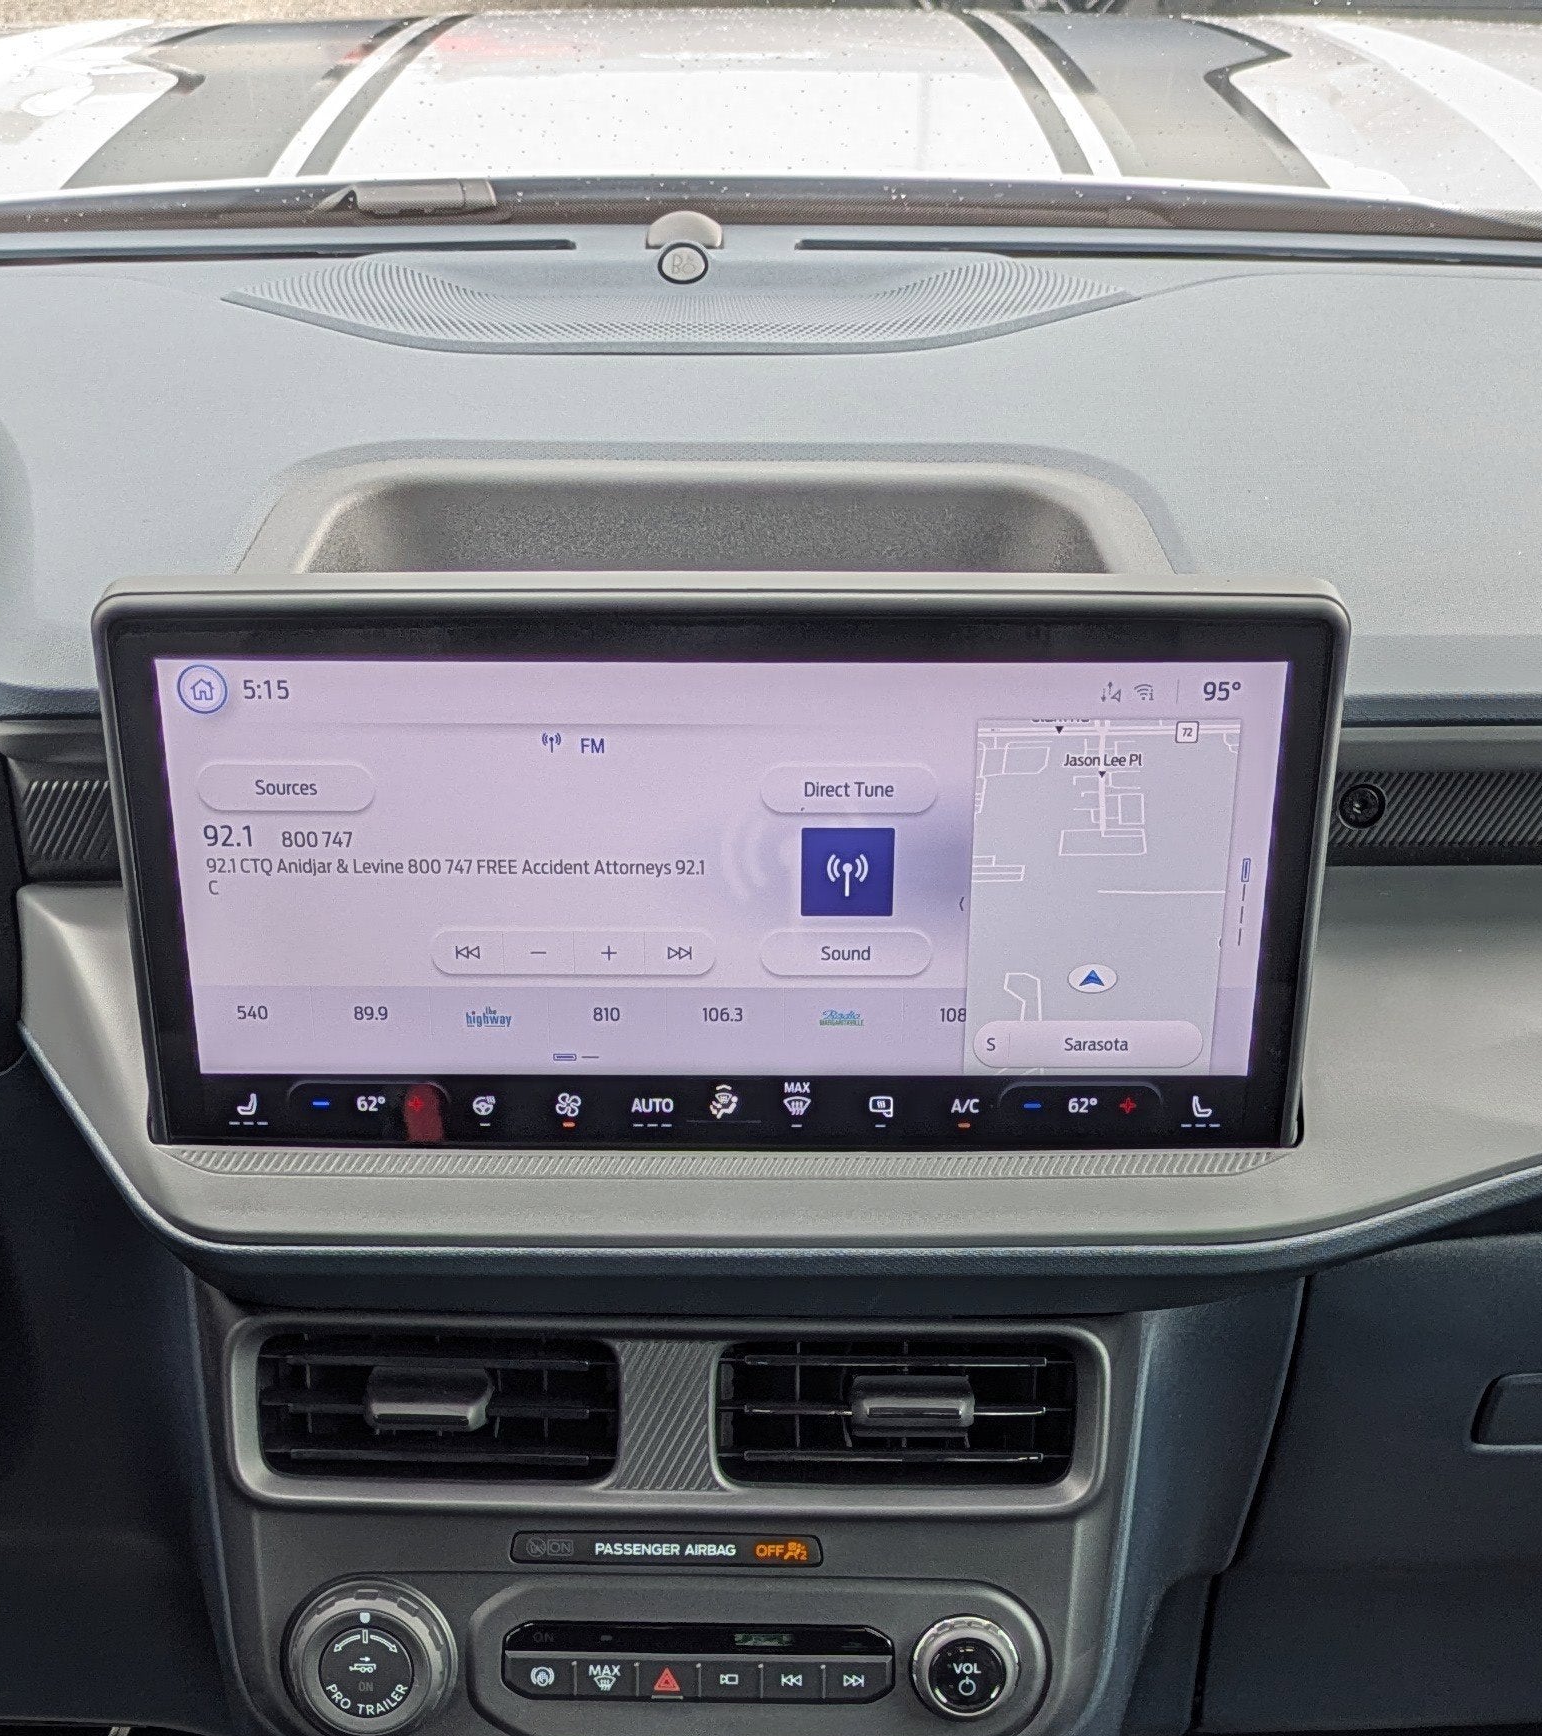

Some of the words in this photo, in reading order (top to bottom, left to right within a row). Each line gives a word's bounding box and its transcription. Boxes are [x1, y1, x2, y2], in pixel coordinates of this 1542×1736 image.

[242, 679, 290, 701] 5:15
[1202, 681, 1242, 702] 95°
[1182, 727, 1193, 738] 72
[580, 739, 605, 754] FM
[1063, 753, 1101, 767] Jason
[1103, 754, 1127, 766] Lee
[1129, 754, 1142, 766] Pl
[255, 779, 318, 796] Sources
[803, 781, 850, 799] Direct
[854, 782, 895, 799] Tune
[203, 825, 253, 847] 92.1
[281, 831, 318, 848] 800
[321, 831, 353, 848] 747
[205, 858, 236, 874] 92.1
[240, 858, 273, 877] CTQ
[276, 858, 332, 877] Anidjar
[336, 859, 349, 874] &
[353, 859, 404, 874] Levine
[407, 859, 442, 875] 800
[445, 859, 473, 875] 747
[477, 860, 518, 875] FREE
[521, 859, 590, 875] Accident
[594, 859, 672, 878] Attorneys
[675, 860, 705, 876] 92.1
[208, 880, 219, 896] C
[820, 945, 871, 962] Sound
[236, 1006, 269, 1021] 540
[353, 1006, 388, 1022] 89.9
[466, 1012, 512, 1027] highway
[592, 1007, 621, 1022] 810
[702, 1007, 744, 1024] 106.3
[986, 1037, 997, 1052] S
[1063, 1036, 1129, 1053] Sarasota
[784, 1082, 811, 1094] MAX
[356, 1096, 386, 1112] 62°
[631, 1098, 673, 1114] AUTO
[951, 1097, 980, 1116] A/C
[1068, 1097, 1098, 1114] 62°
[594, 1542, 680, 1556] PASSENGER
[684, 1543, 737, 1557] AIRBAG
[756, 1544, 784, 1559] OFF
[588, 1665, 621, 1676] MAX
[953, 1663, 981, 1675] VOL
[326, 1683, 352, 1711] PRO
[357, 1683, 409, 1717] TRAILER
